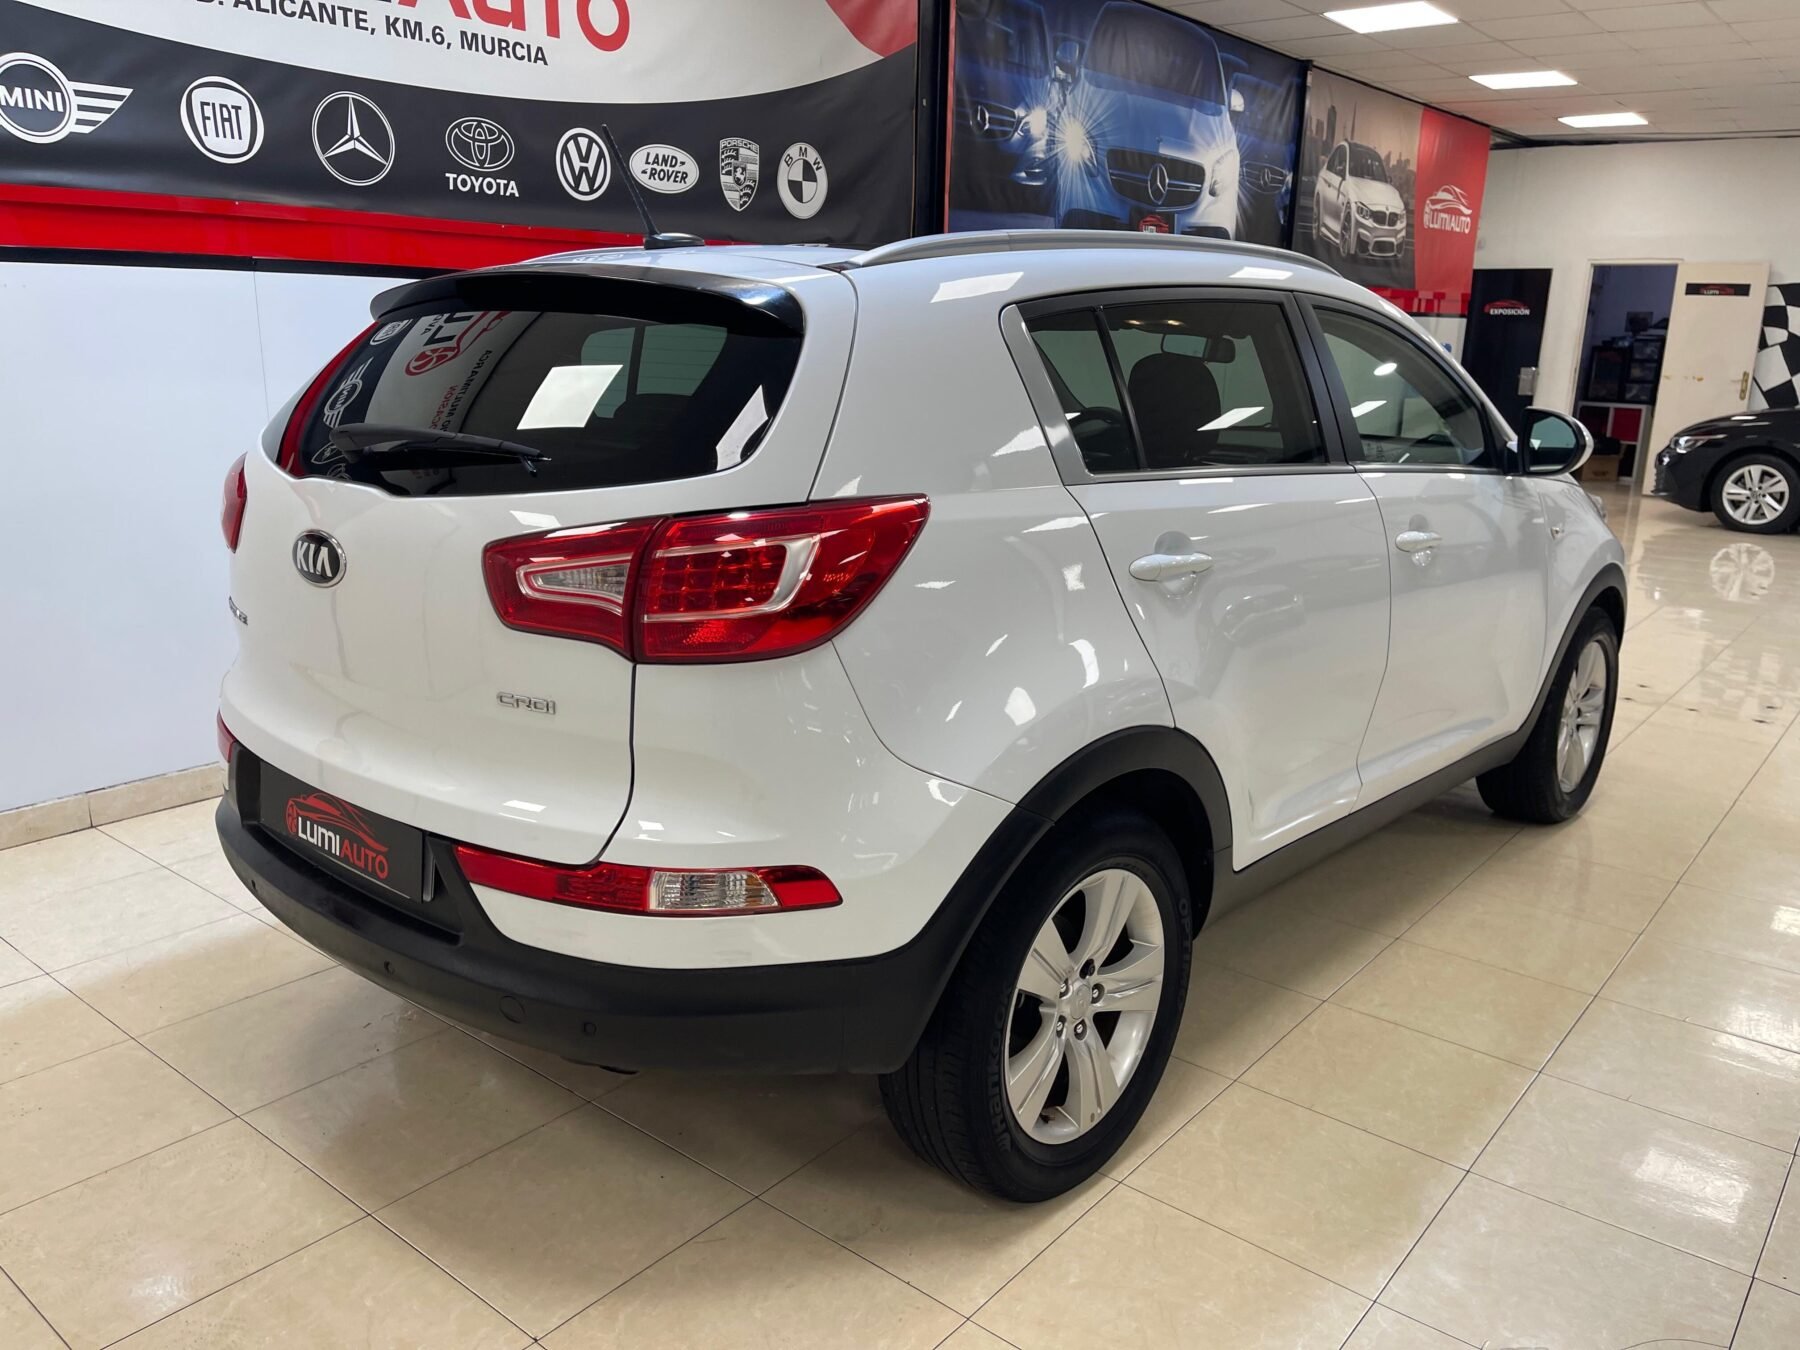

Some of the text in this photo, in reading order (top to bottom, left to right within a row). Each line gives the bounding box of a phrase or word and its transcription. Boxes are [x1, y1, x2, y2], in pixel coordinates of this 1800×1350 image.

[385, 15, 452, 50] KM.6,
[460, 30, 549, 66] MURCIA
[0, 85, 64, 113] MINI
[200, 101, 243, 140] FIAT
[721, 138, 759, 152] PORSCHE
[645, 152, 679, 168] LAND
[445, 173, 520, 198] TOYOTA
[648, 168, 689, 184] ROVER
[1490, 306, 1531, 316] EXPOSICIÓN
[296, 540, 333, 577] KIA
